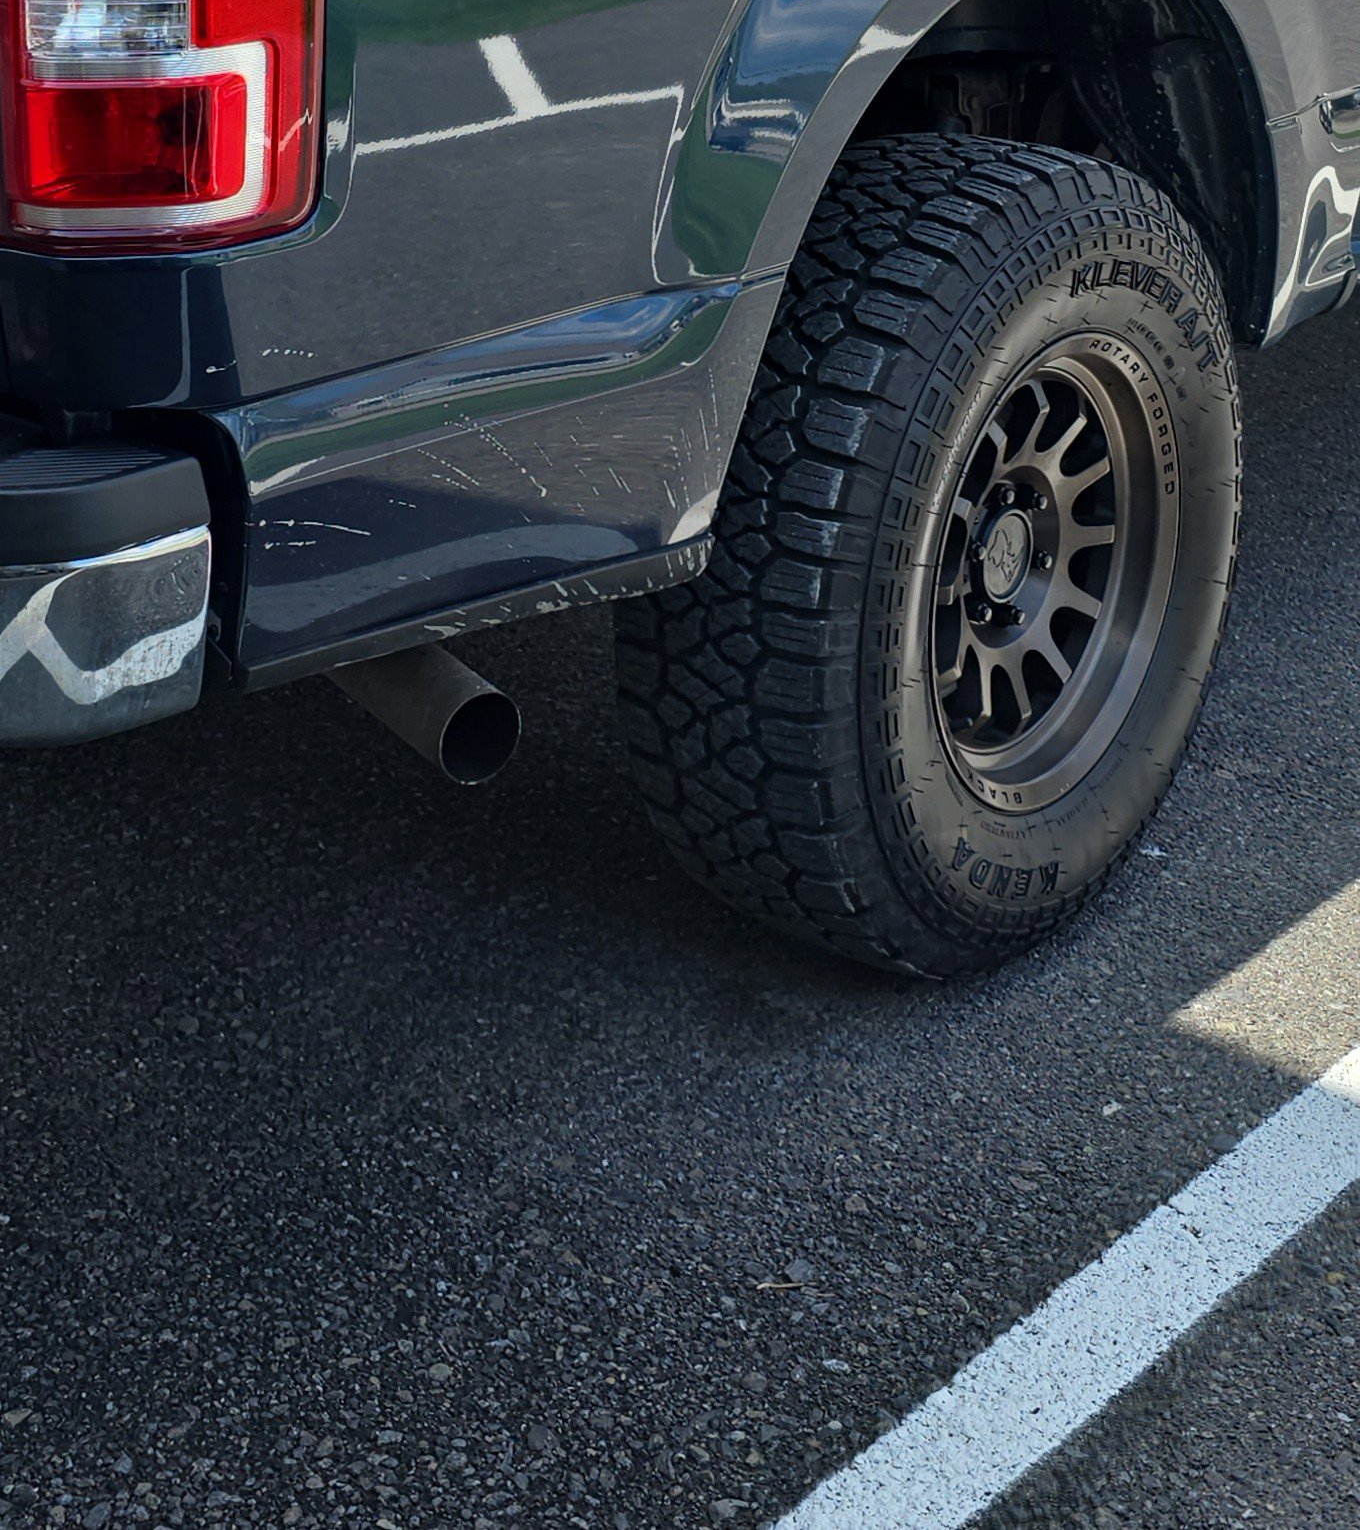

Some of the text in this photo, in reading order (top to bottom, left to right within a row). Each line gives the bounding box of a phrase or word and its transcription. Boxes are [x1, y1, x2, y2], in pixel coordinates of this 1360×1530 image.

[1070, 259, 1186, 314] KLEVER
[1089, 339, 1149, 385] ROTARY
[1146, 392, 1176, 496] FORGED
[967, 768, 1023, 805] BLACK
[952, 836, 1060, 898] KENDA
